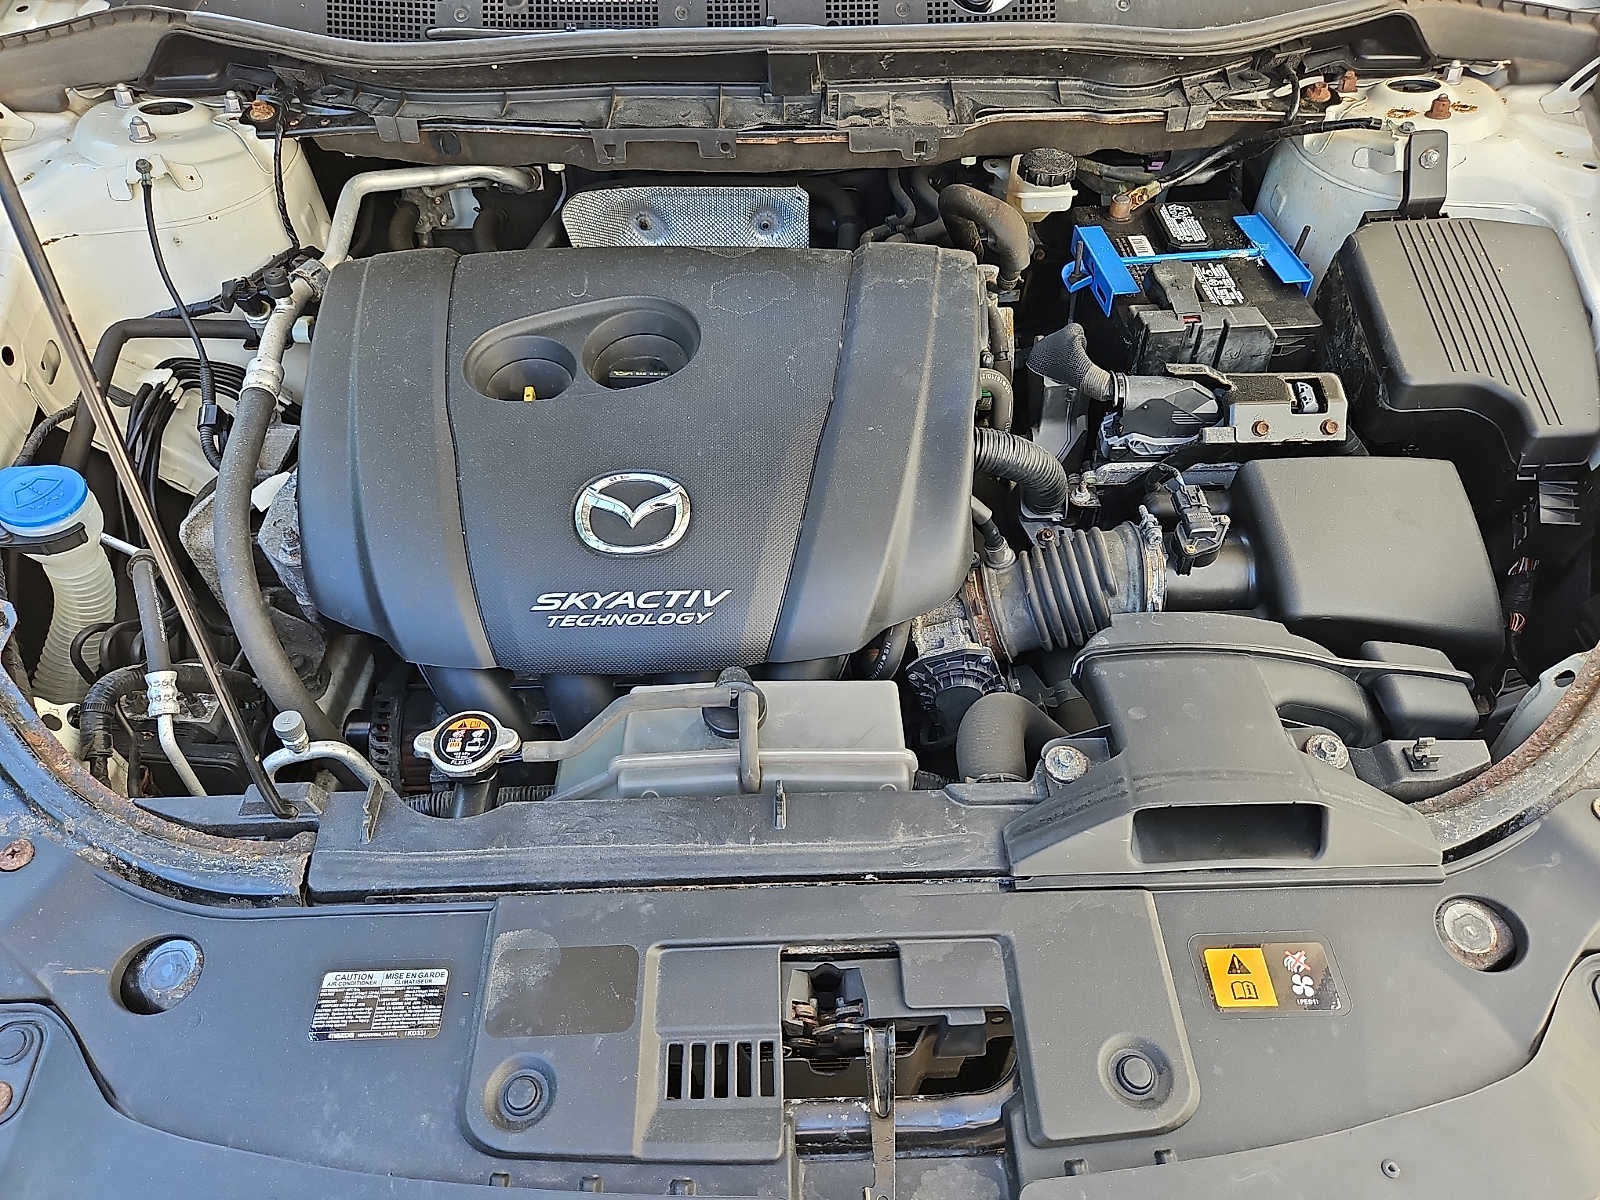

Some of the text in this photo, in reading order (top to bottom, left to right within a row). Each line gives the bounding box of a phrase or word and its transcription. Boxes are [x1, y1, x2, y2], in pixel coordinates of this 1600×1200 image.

[530, 589, 732, 611] SKYACTIV
[547, 612, 714, 628] TECHNOLOGY
[334, 973, 374, 981] CAUTION
[384, 972, 405, 980] MISE
